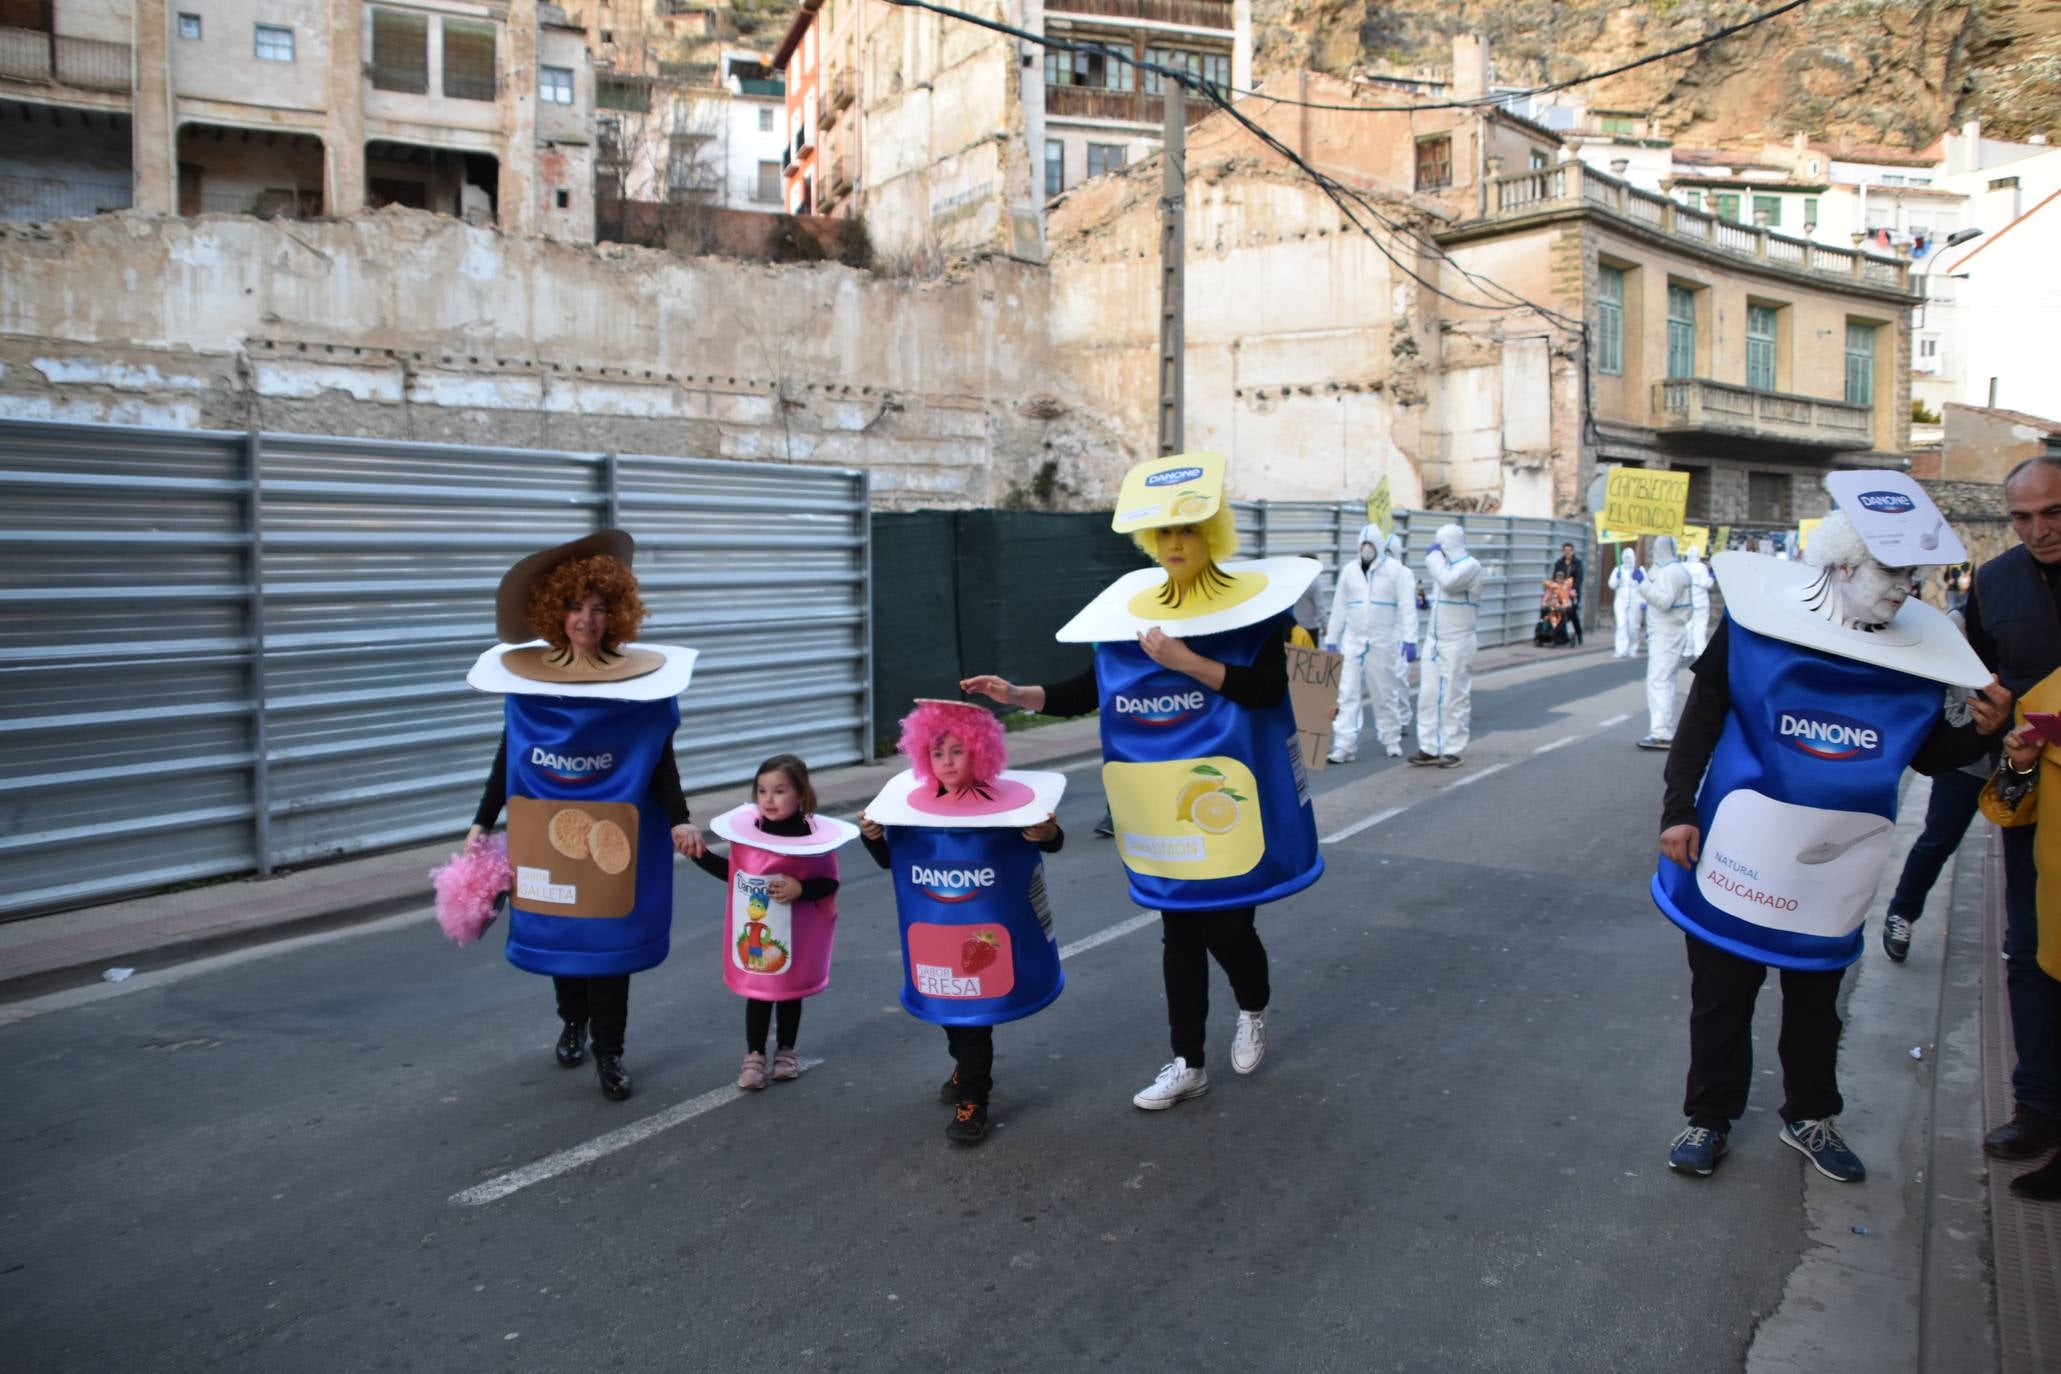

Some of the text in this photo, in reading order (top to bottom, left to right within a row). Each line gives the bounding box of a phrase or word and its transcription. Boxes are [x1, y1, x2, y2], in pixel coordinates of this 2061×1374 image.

[1609, 475, 1687, 504] CAMBIEMOS
[1607, 502, 1677, 530] EL MUNDO
[1713, 852, 1760, 881] NATURAL
[1706, 870, 1799, 912] AZUCARADO
[919, 965, 950, 977] SABOR
[919, 976, 979, 995] FRESA
